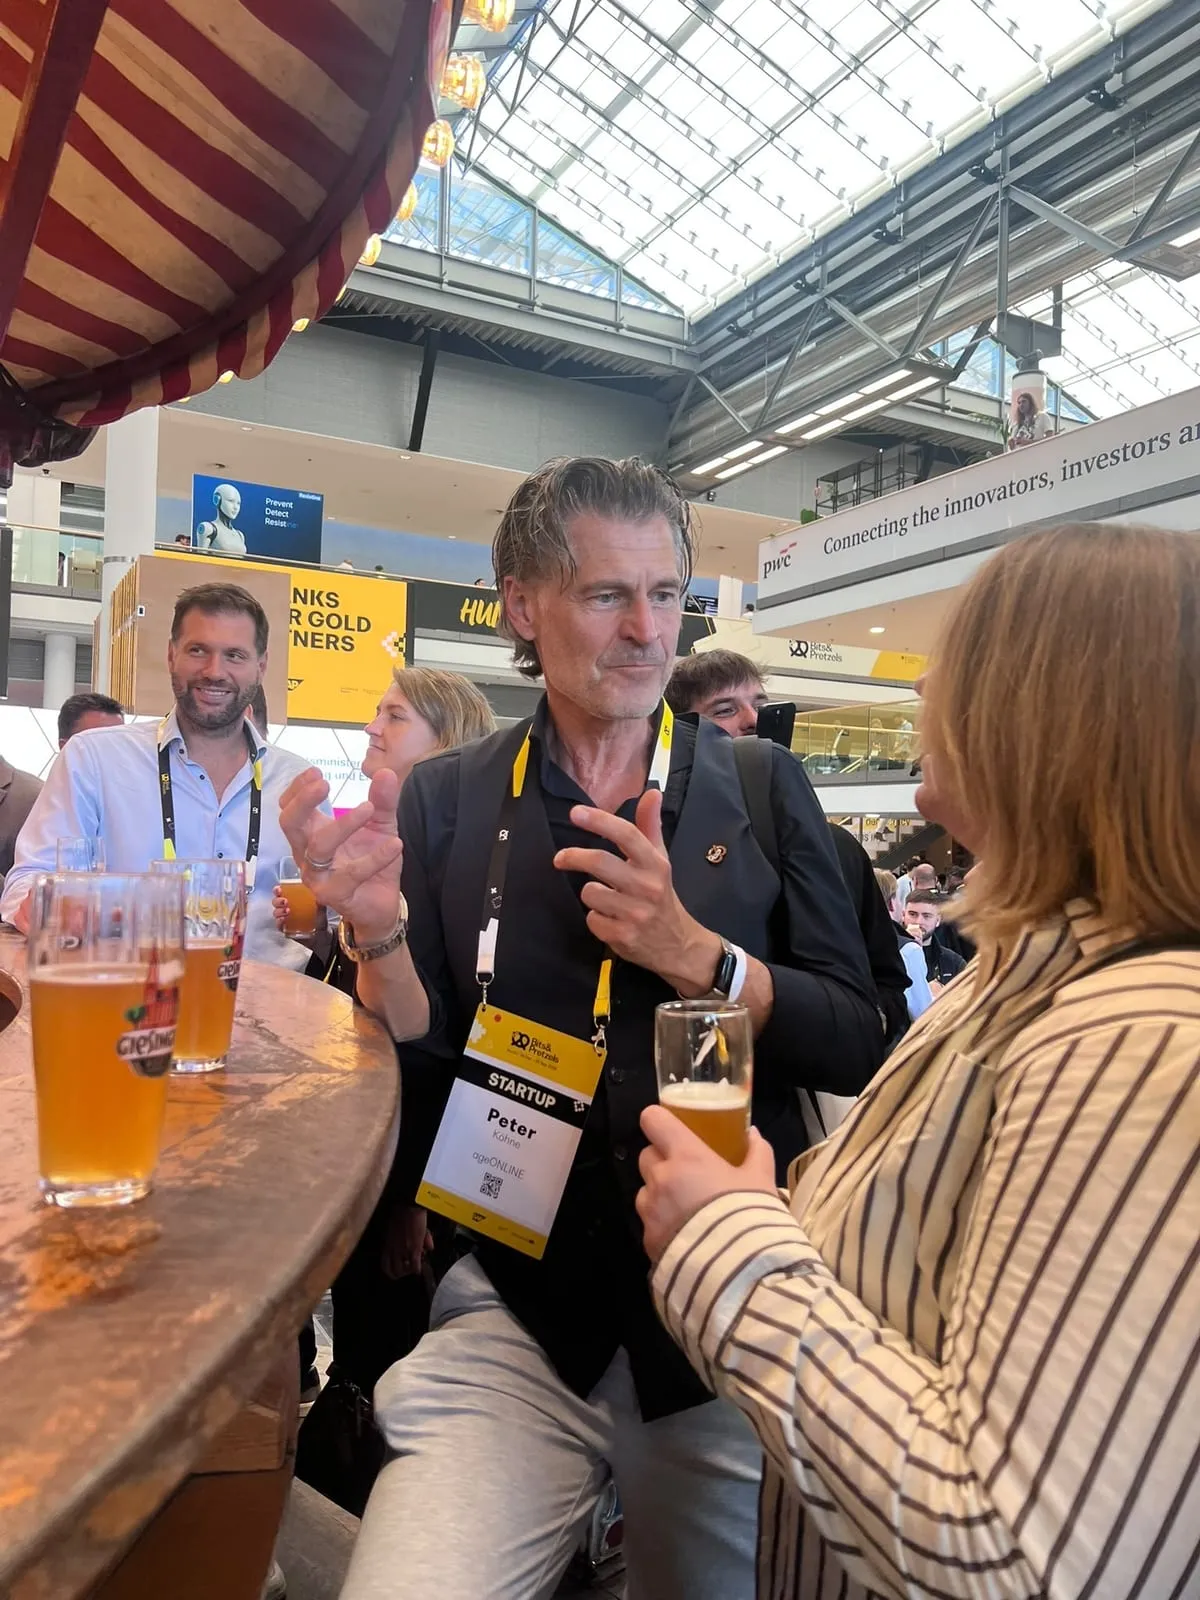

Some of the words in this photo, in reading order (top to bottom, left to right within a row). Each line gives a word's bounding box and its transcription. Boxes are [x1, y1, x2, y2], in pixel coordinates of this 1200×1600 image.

[265, 497, 294, 509] Prevent
[824, 517, 908, 554] Connecting
[913, 505, 940, 527] the
[945, 471, 1054, 517] innovators,
[1061, 432, 1170, 481] investors
[265, 507, 289, 518] Detect
[763, 553, 792, 579] pwc
[308, 610, 372, 633] GOLD
[290, 629, 355, 652] NERS
[810, 641, 832, 652] Bits&
[810, 652, 843, 663] Pretzels
[529, 1045, 560, 1063] Pretzels
[531, 1037, 551, 1052] Bits&
[488, 1072, 556, 1108] STARTUP
[487, 1107, 537, 1139] Peter
[472, 1151, 526, 1179] ageONLINE
